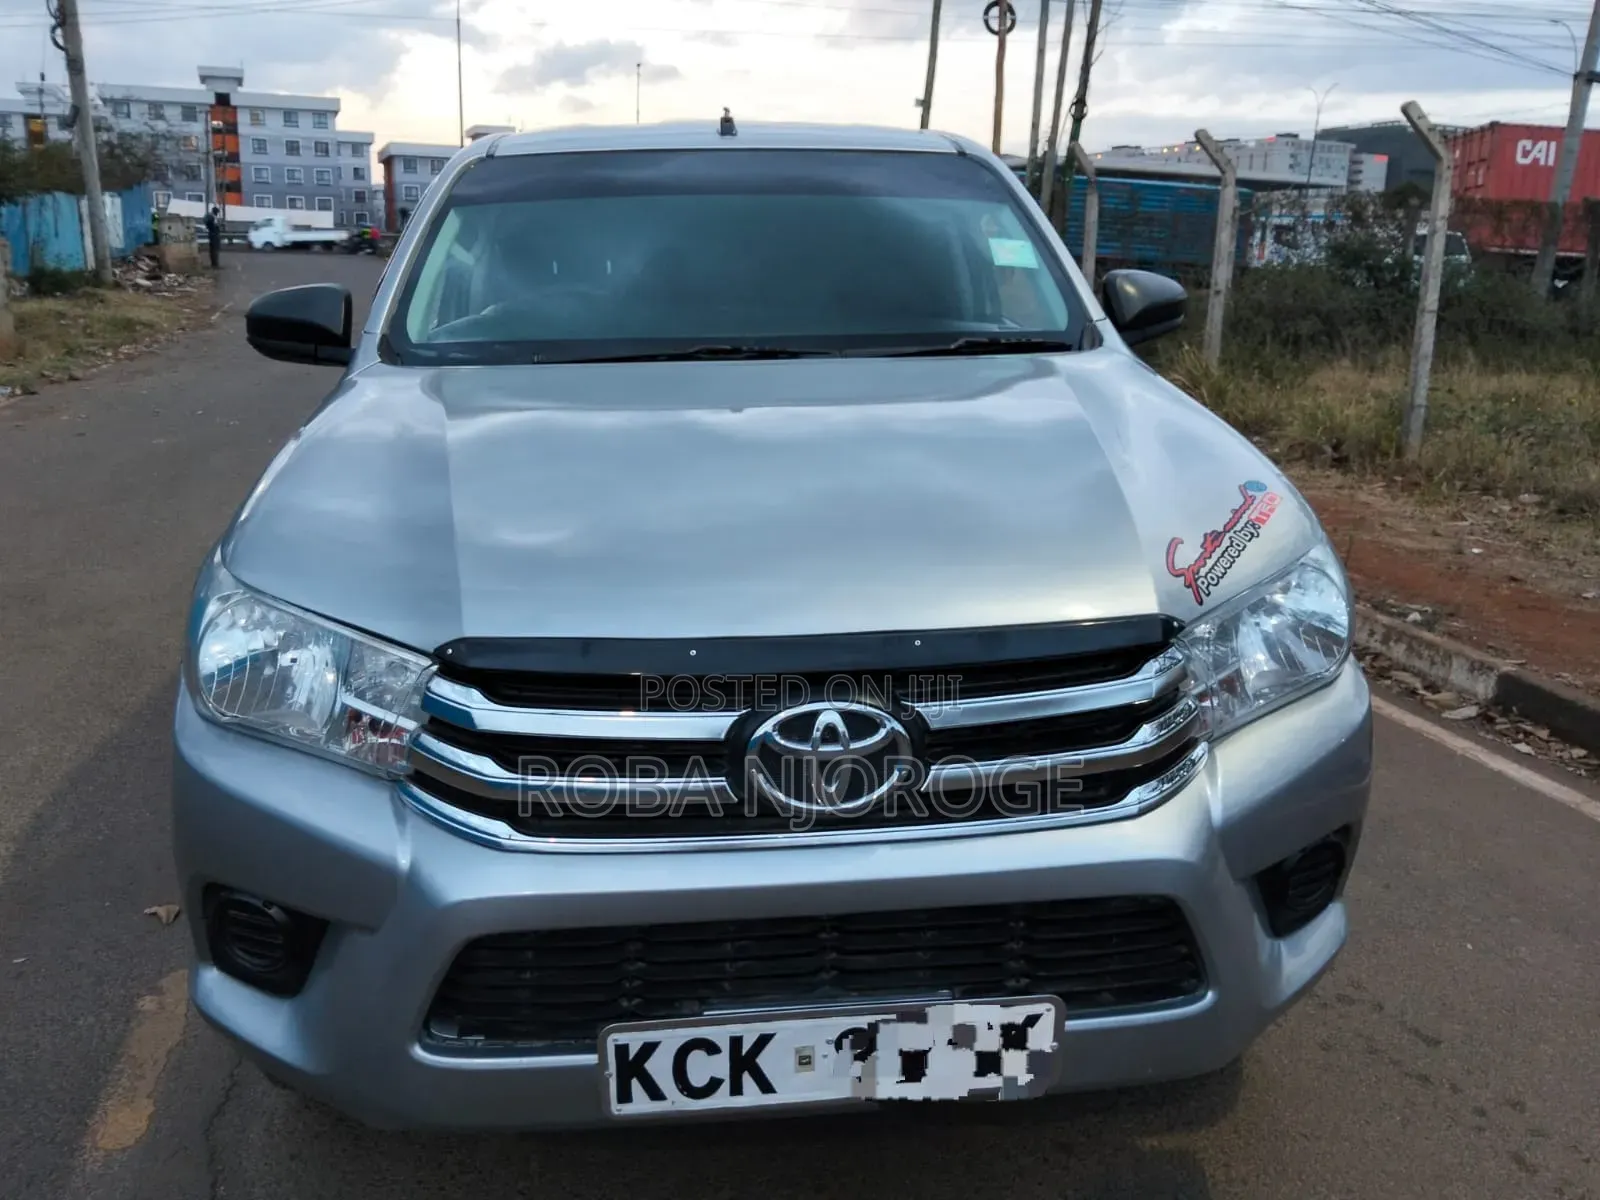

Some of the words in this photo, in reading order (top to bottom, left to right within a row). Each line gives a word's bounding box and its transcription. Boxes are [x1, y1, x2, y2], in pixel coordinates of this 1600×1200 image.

[1515, 139, 1557, 167] CAI
[1196, 534, 1247, 597] Powered
[613, 1032, 778, 1105] KCK
